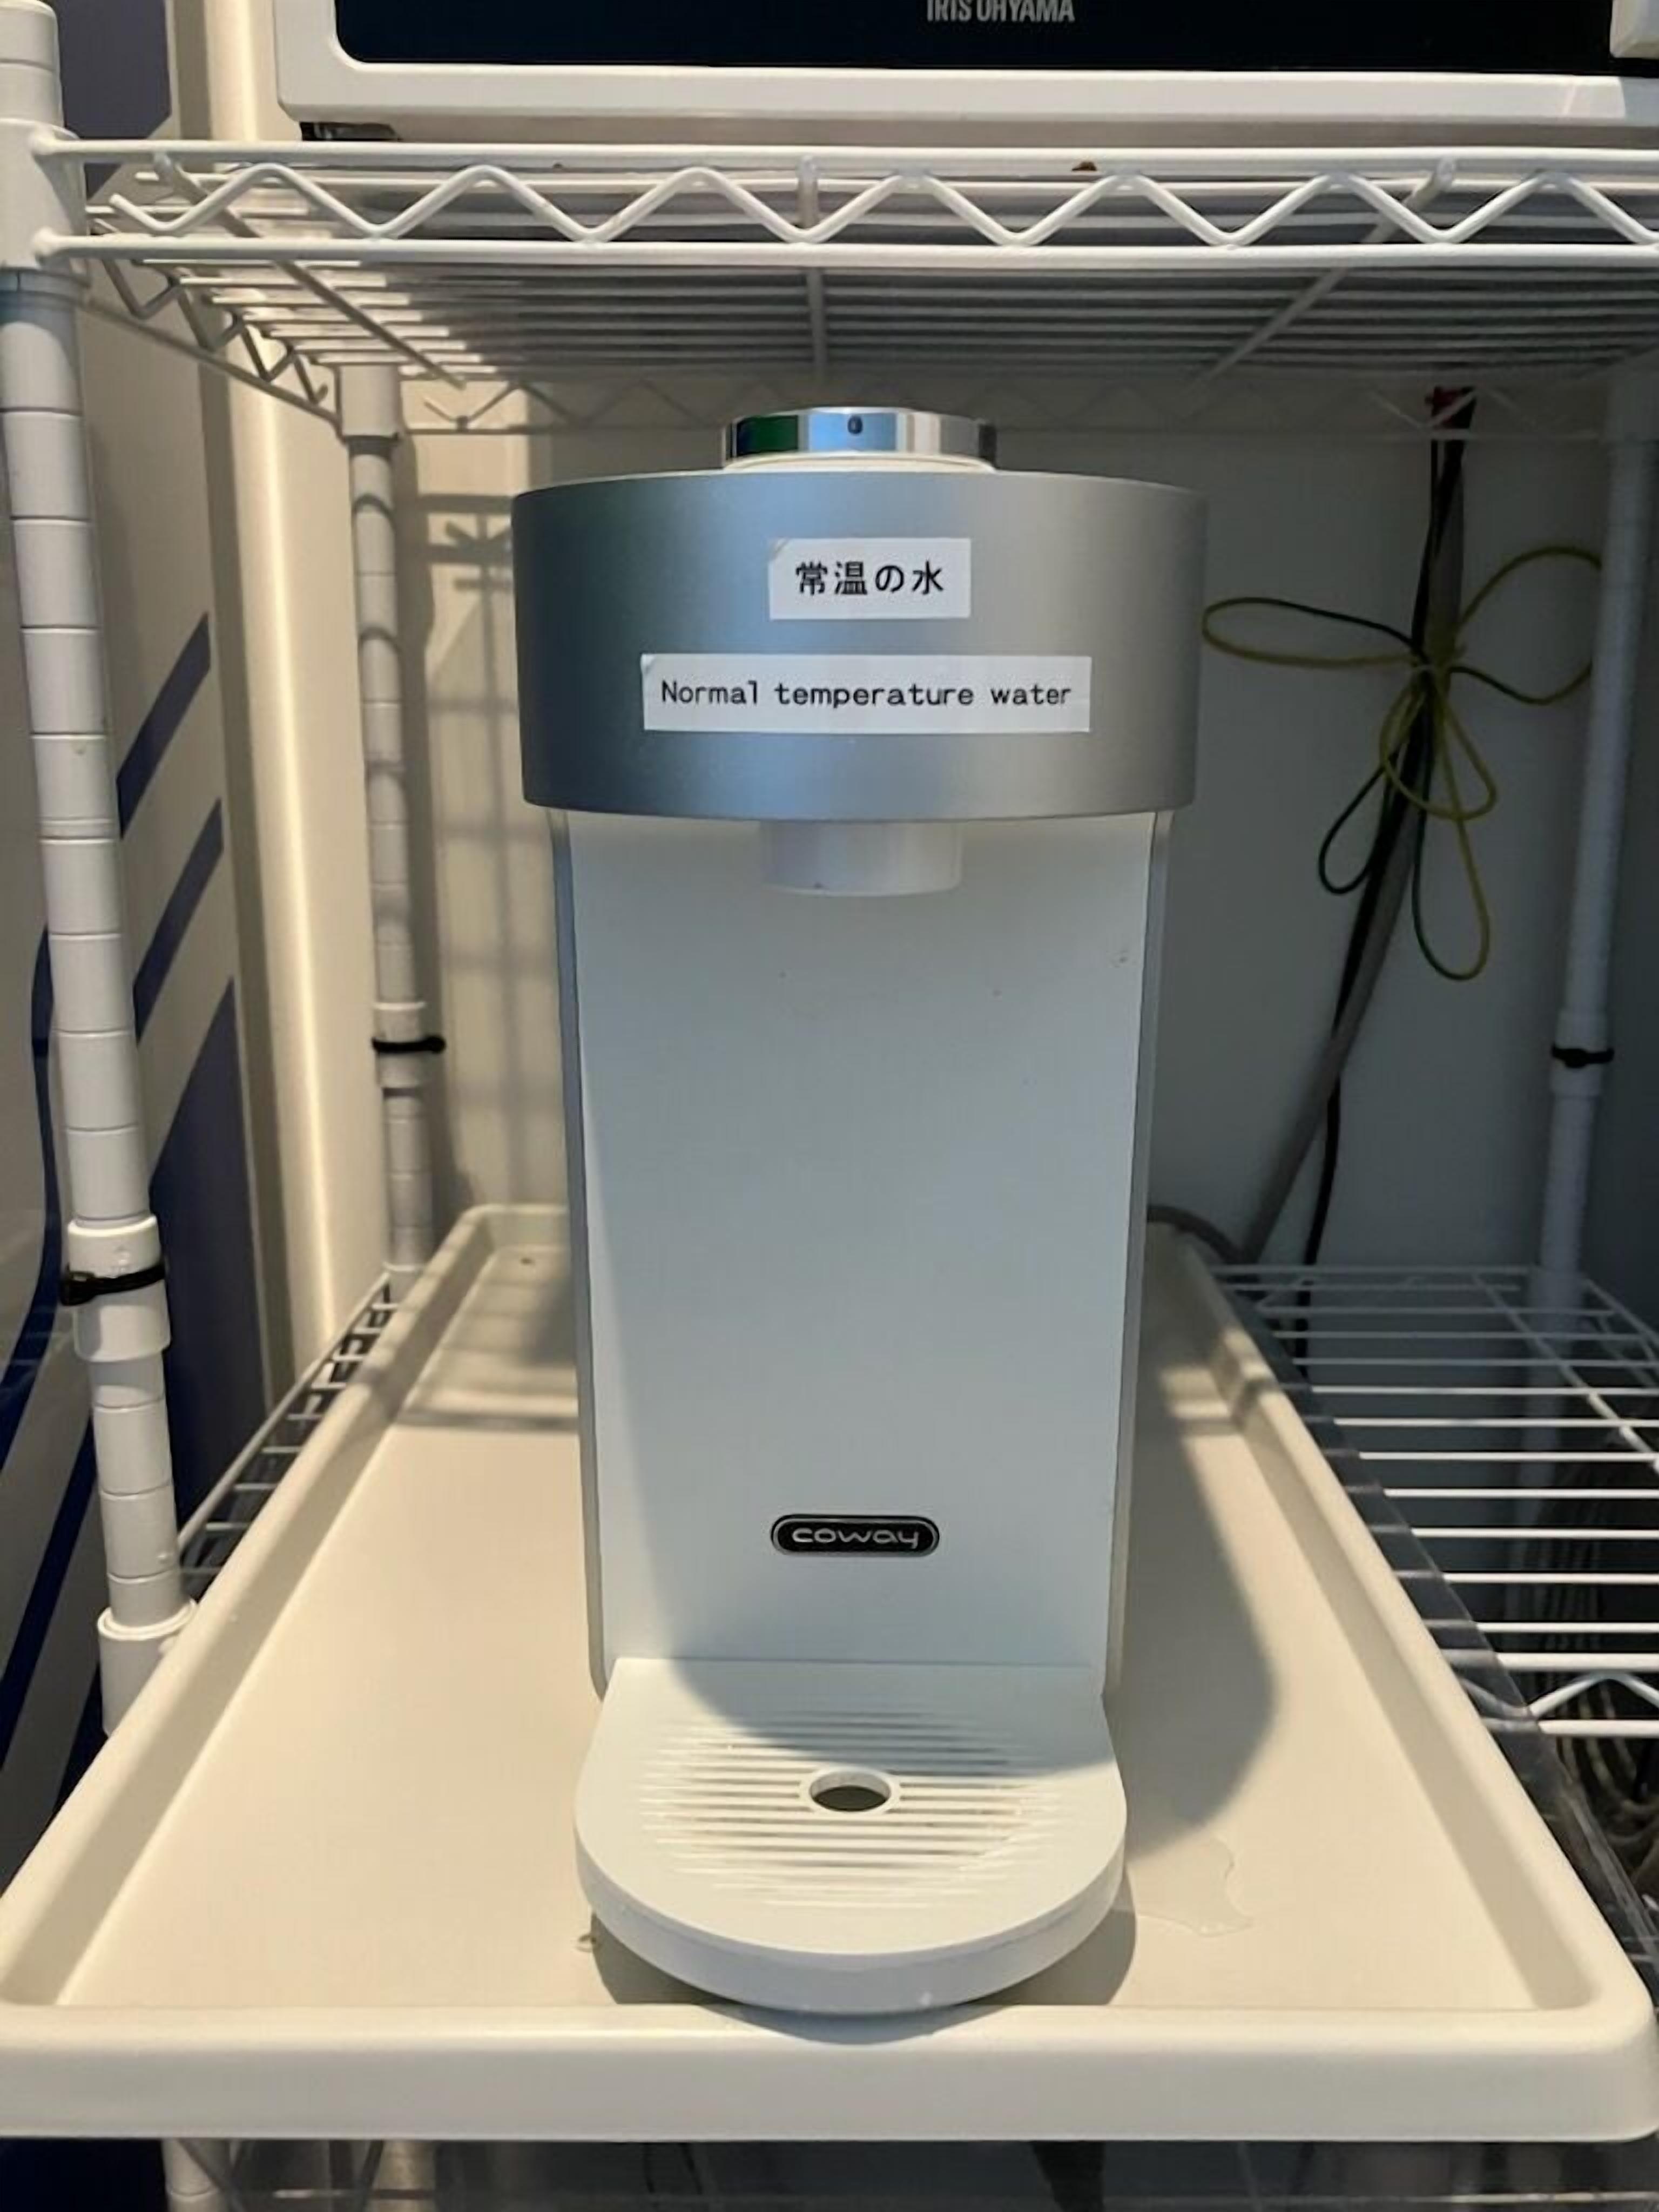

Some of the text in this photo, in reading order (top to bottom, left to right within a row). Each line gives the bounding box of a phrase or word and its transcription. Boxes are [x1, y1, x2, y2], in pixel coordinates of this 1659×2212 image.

[928, 0, 971, 22] IRIS
[796, 561, 944, 595] 常温の水
[662, 680, 1071, 709] Normal temperature water
[792, 1528, 919, 1549] coway
